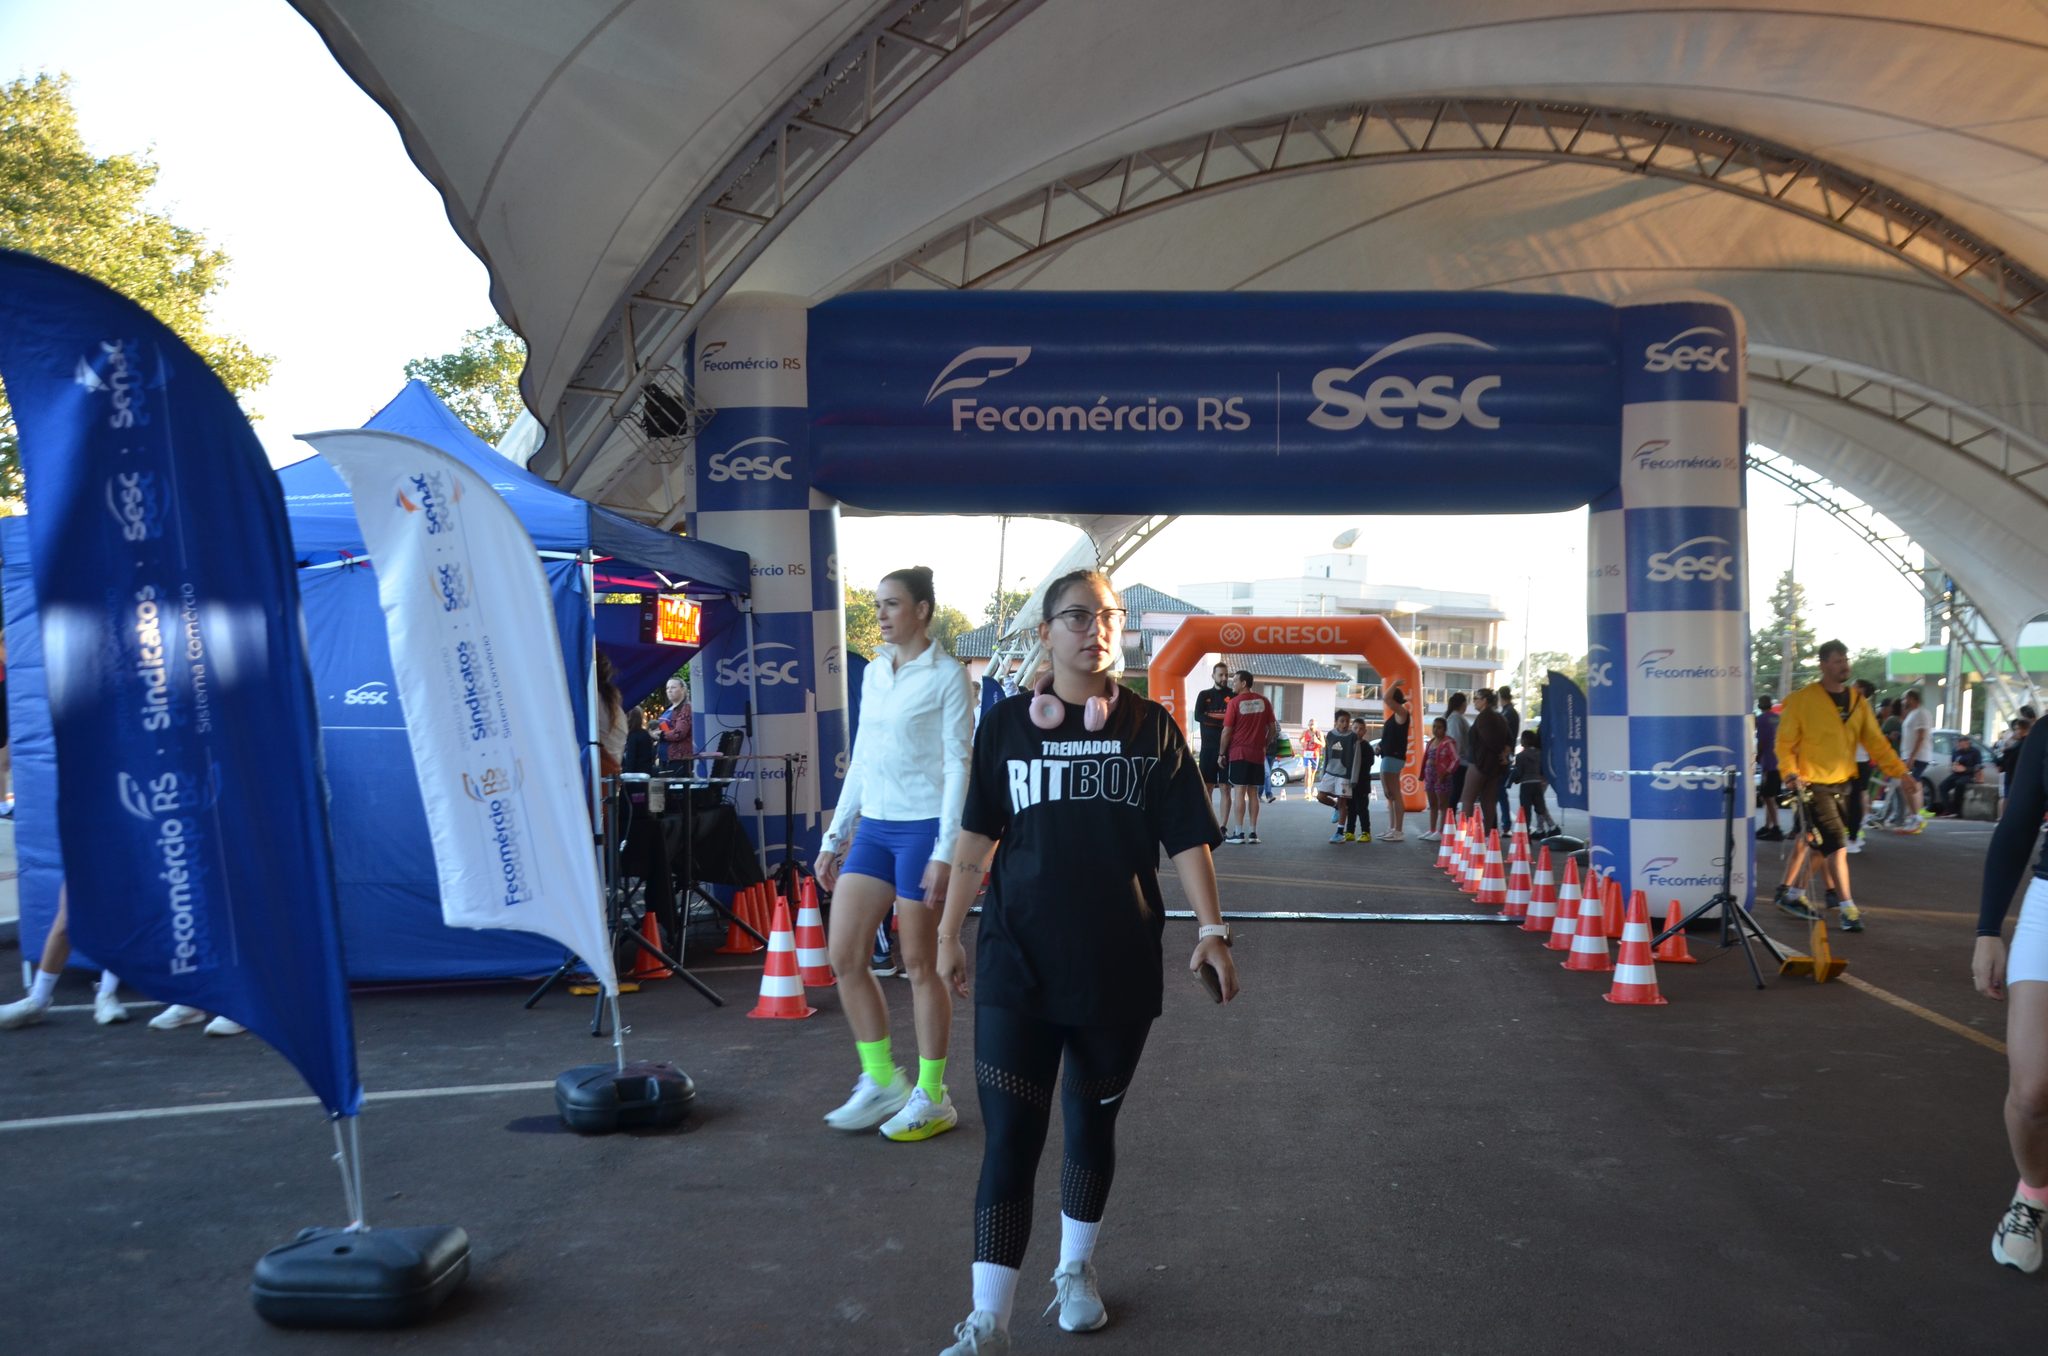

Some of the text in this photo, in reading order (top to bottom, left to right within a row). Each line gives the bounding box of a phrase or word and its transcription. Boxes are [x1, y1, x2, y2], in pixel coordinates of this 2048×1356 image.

[703, 357, 801, 372] Fecomércio RS
[1643, 342, 1730, 373] Sesc
[952, 367, 1501, 432] Fecomércio RS Sesc
[707, 453, 793, 482] Sesc
[1640, 456, 1722, 470] Fecomércio
[750, 563, 806, 576] ércio RS
[1646, 552, 1733, 582] Sesc
[1253, 626, 1348, 645] CRESOL
[136, 584, 171, 731] Sindicatos
[1587, 661, 1613, 687] sc
[1645, 666, 1742, 679] Fecomércio RS
[185, 663, 213, 734] Sistema
[456, 640, 487, 742] Sindicatos
[1041, 740, 1122, 756] TREINADOR
[149, 771, 181, 813] RS
[480, 768, 498, 796] RS
[488, 799, 520, 908] Fecomércio
[1649, 874, 1725, 887] Fecomérci
[156, 817, 198, 976] Fecomércio
